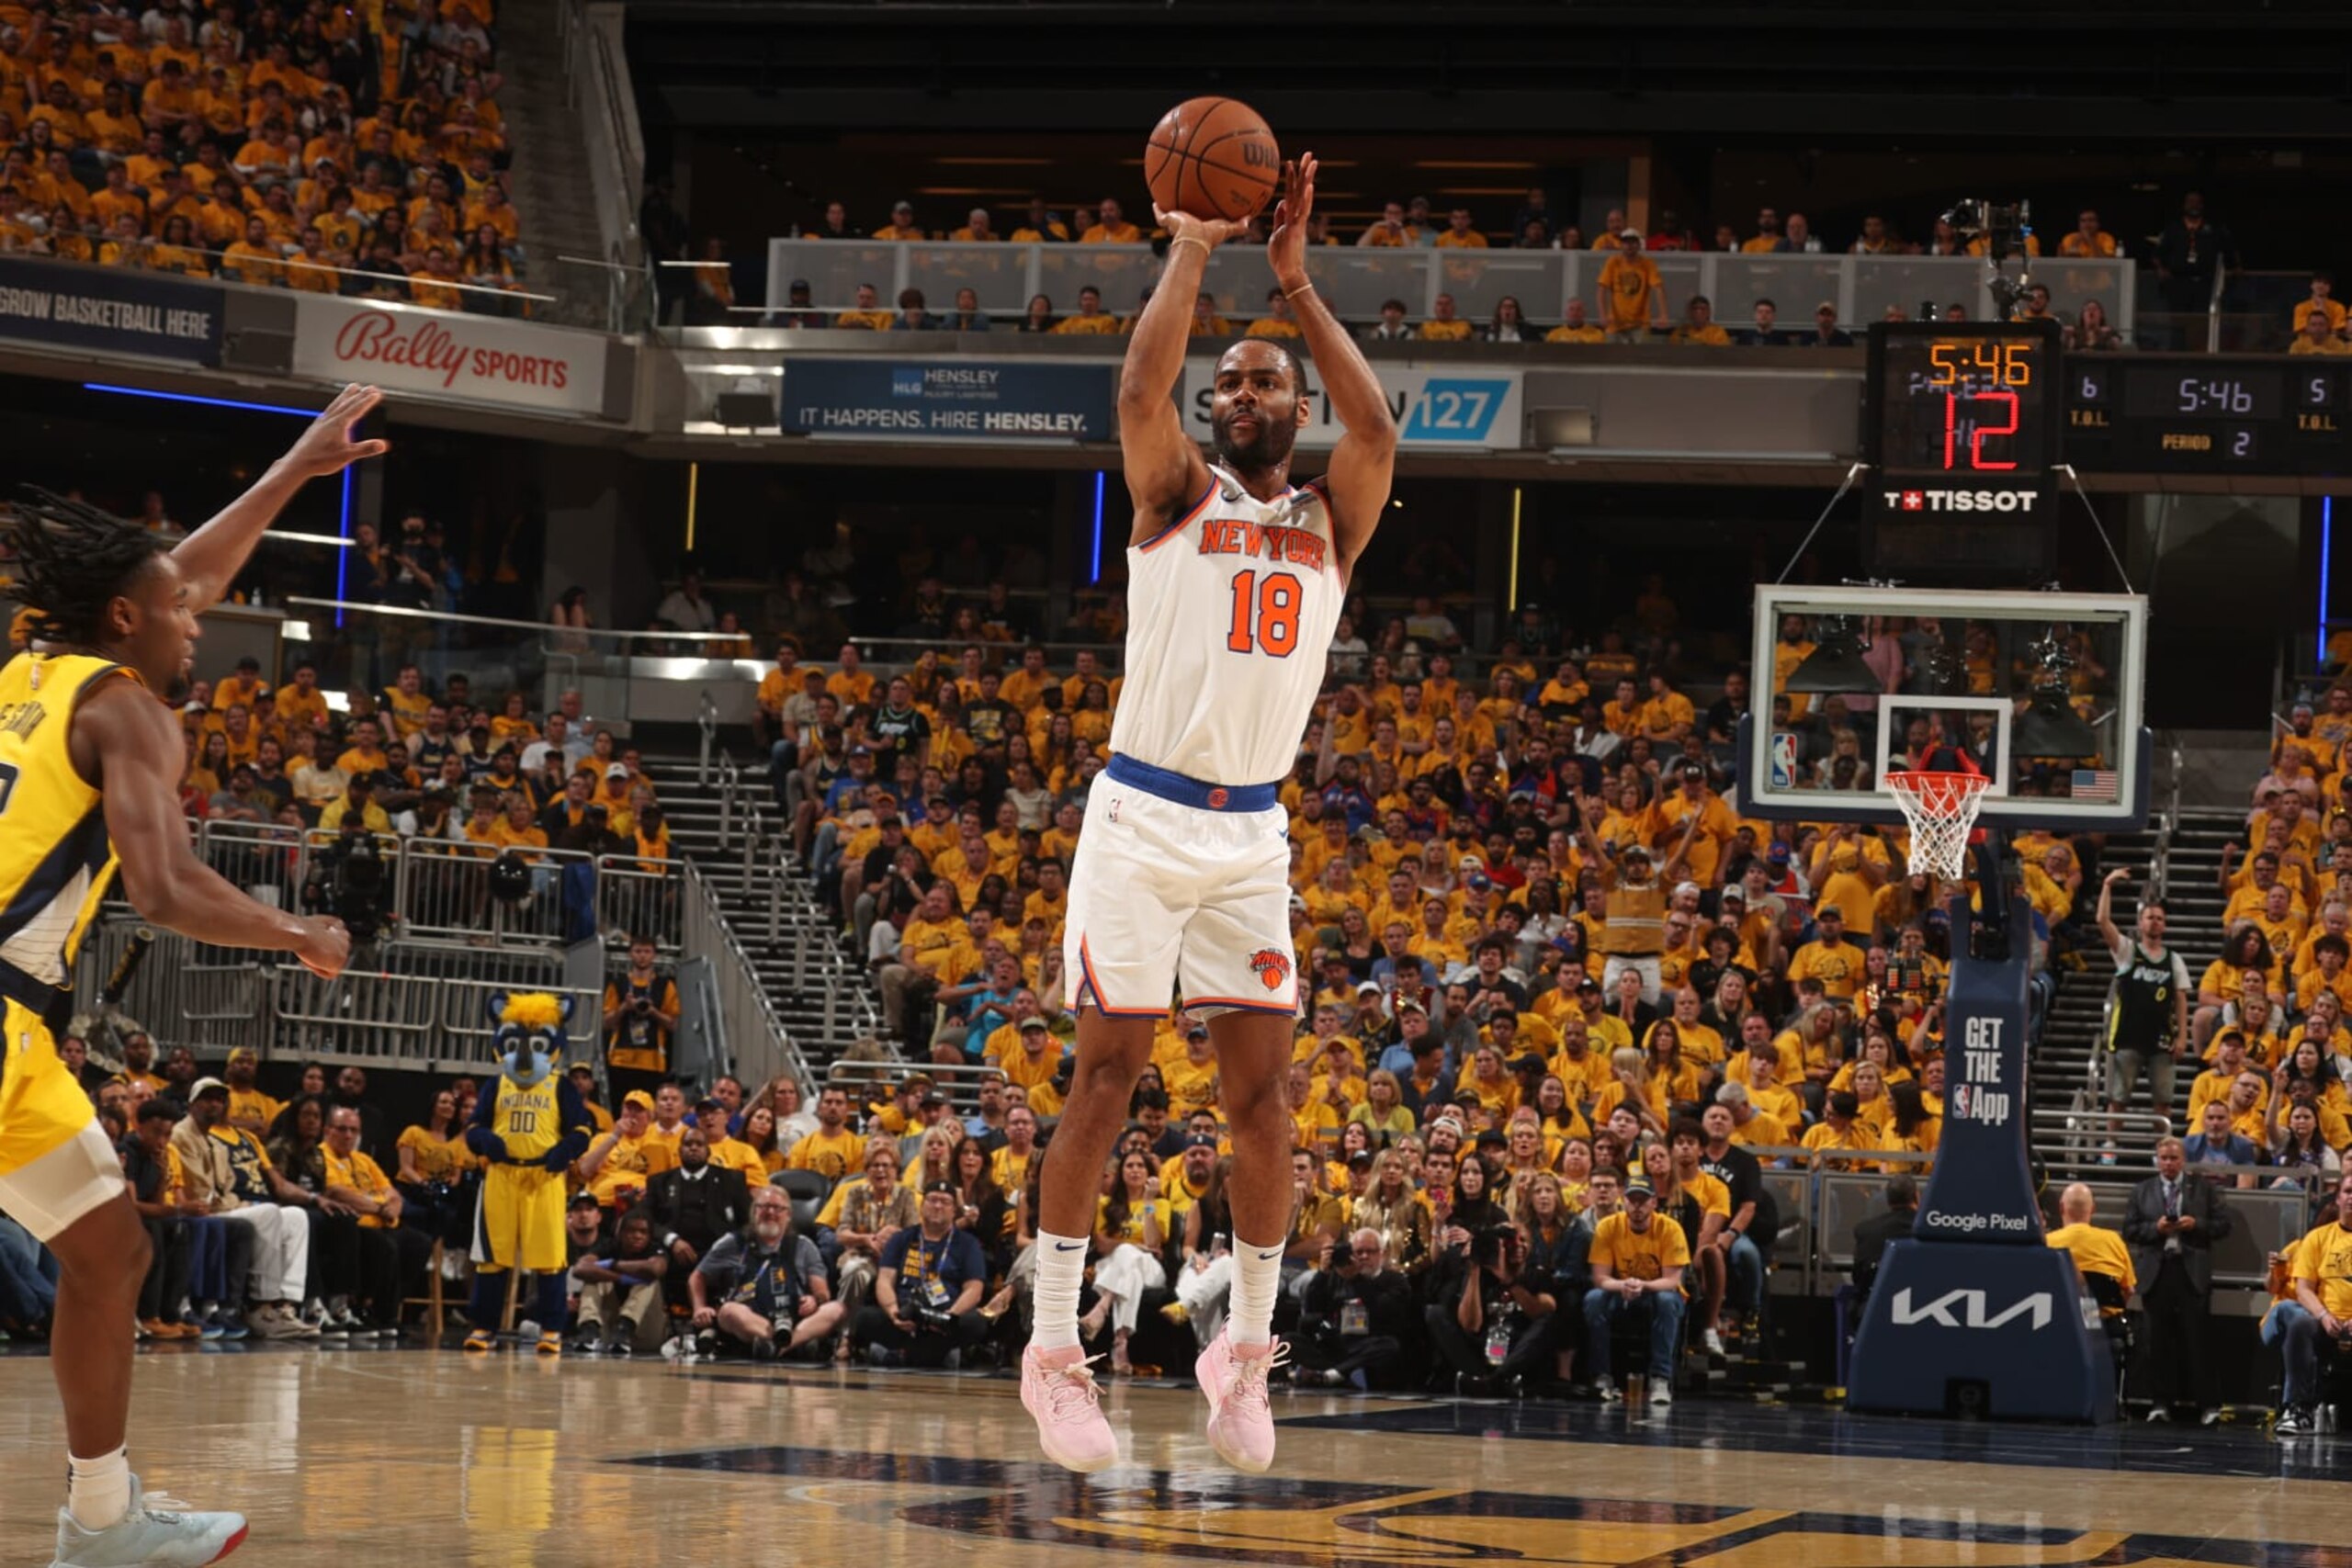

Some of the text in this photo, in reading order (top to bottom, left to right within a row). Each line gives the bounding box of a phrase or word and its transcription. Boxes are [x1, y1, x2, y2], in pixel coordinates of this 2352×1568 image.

[54, 294, 163, 334] BASKETBALL
[166, 309, 210, 340] HERE
[334, 310, 568, 389] Bally SPORTS
[1931, 344, 2031, 386] 5:46
[893, 381, 922, 394] HLG
[924, 369, 999, 384] HENSLEY
[1419, 390, 1491, 429] 127
[2178, 378, 2253, 412] 5:46
[799, 407, 1088, 432] IT HAPPENS. HIRE HENSLEY.
[1943, 391, 2019, 470] 12
[2162, 434, 2211, 450] PERIOD
[2233, 432, 2250, 456] 2
[1926, 491, 2038, 512] TISSOT
[1198, 519, 1327, 575] NEW YORK
[1227, 569, 1303, 658] 18
[2132, 966, 2170, 984] INDY
[1965, 1016, 2004, 1049] GET
[1964, 1050, 2003, 1083] THE
[500, 1092, 550, 1111] INDIANA
[1971, 1085, 2010, 1125] App
[510, 1111, 536, 1134] 00
[1926, 1210, 2028, 1232] Google Pixel
[1892, 1287, 2052, 1331] KIA
